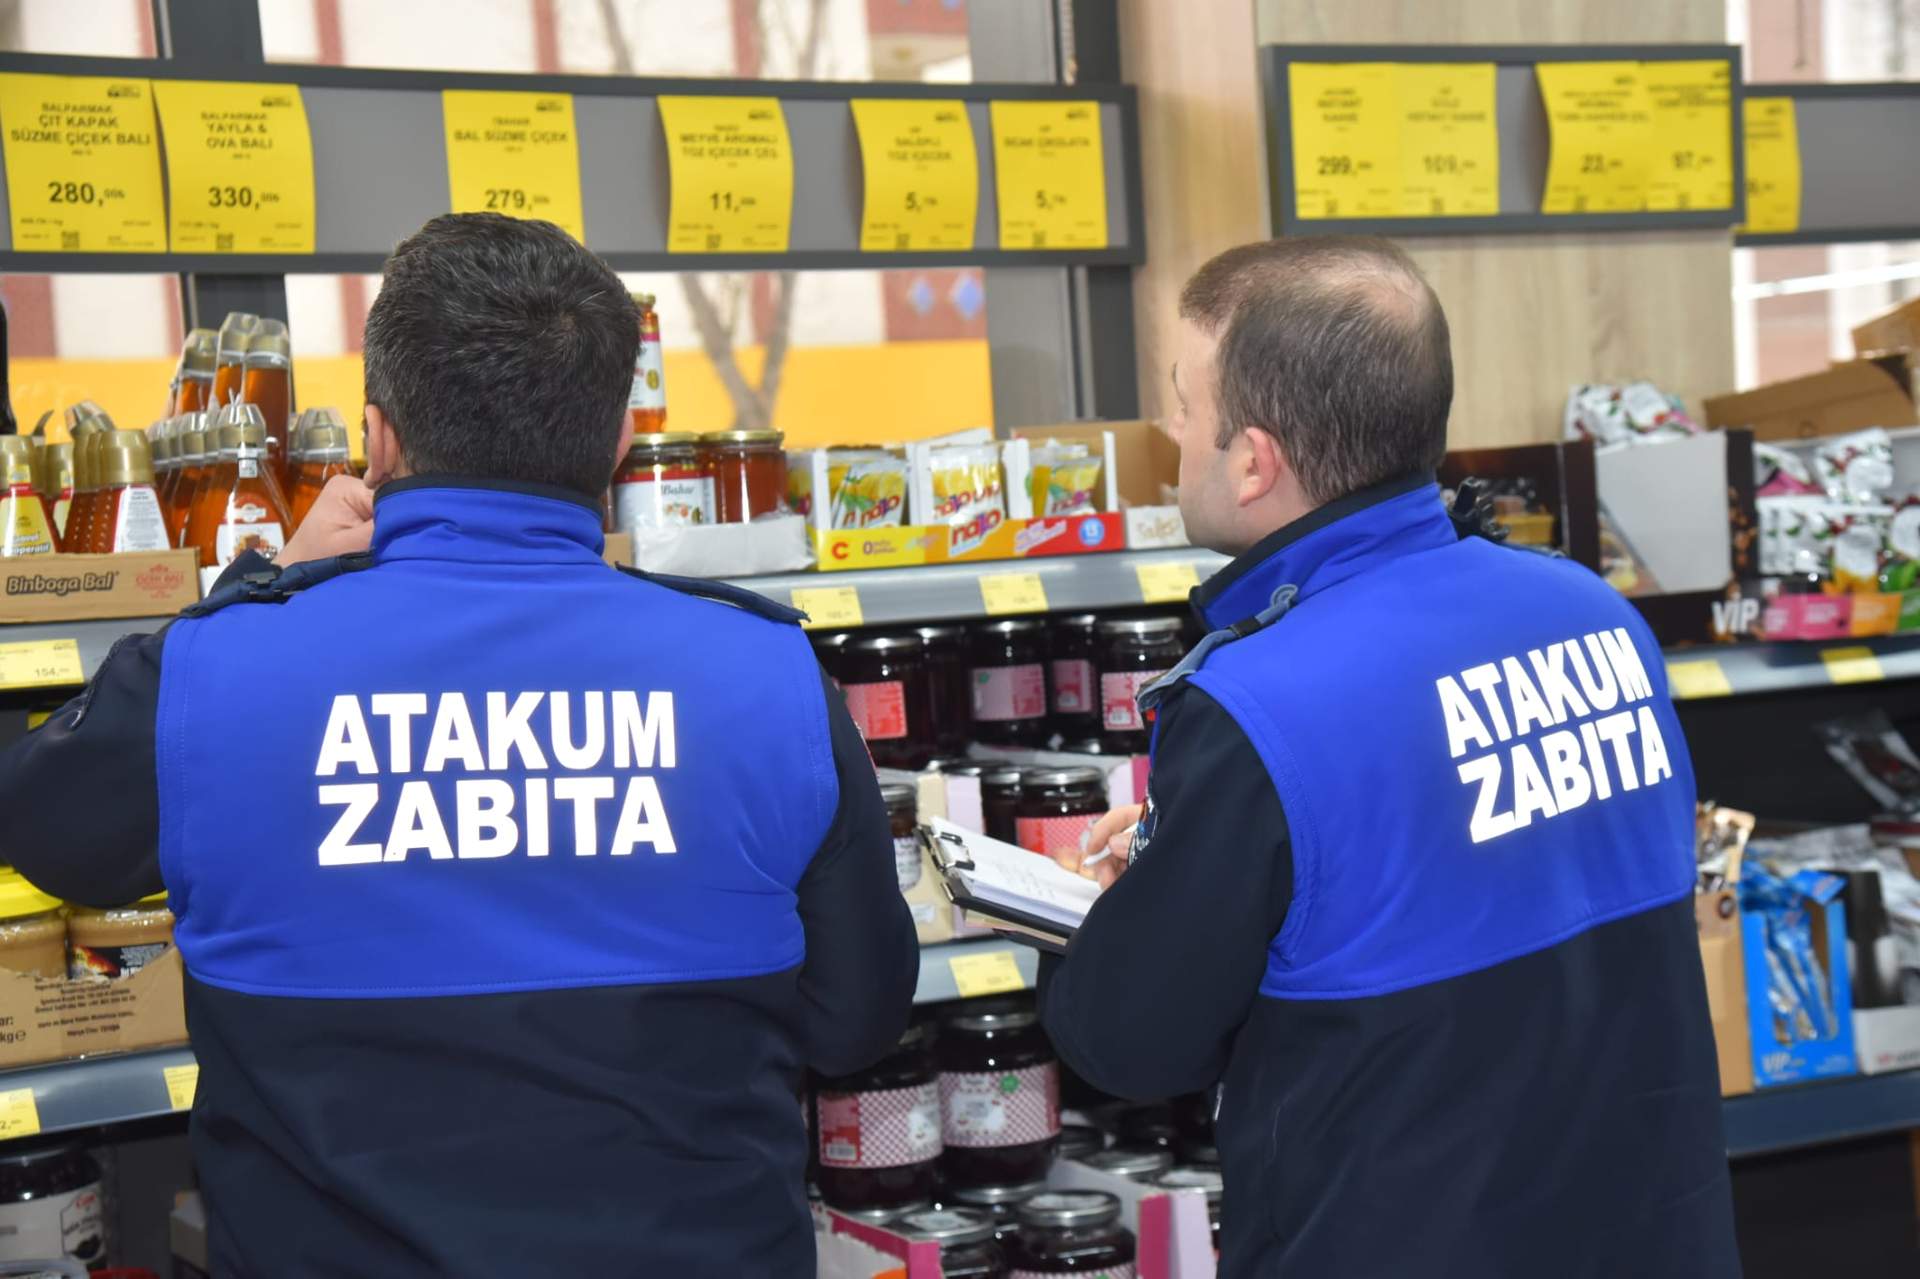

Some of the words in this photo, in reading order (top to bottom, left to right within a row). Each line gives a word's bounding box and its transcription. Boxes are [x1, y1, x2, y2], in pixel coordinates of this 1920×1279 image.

[11, 128, 61, 143] SÜZME
[65, 131, 111, 146] ÇİÇEK
[116, 133, 150, 144] BALI
[66, 116, 119, 128] KAPAK
[951, 509, 1001, 546] najo
[82, 571, 113, 591] Bal
[1436, 627, 1654, 759] ATAKUM
[315, 690, 676, 776] ATAKUM
[1457, 705, 1673, 844] ZABITA
[318, 776, 677, 866] ZABITA
